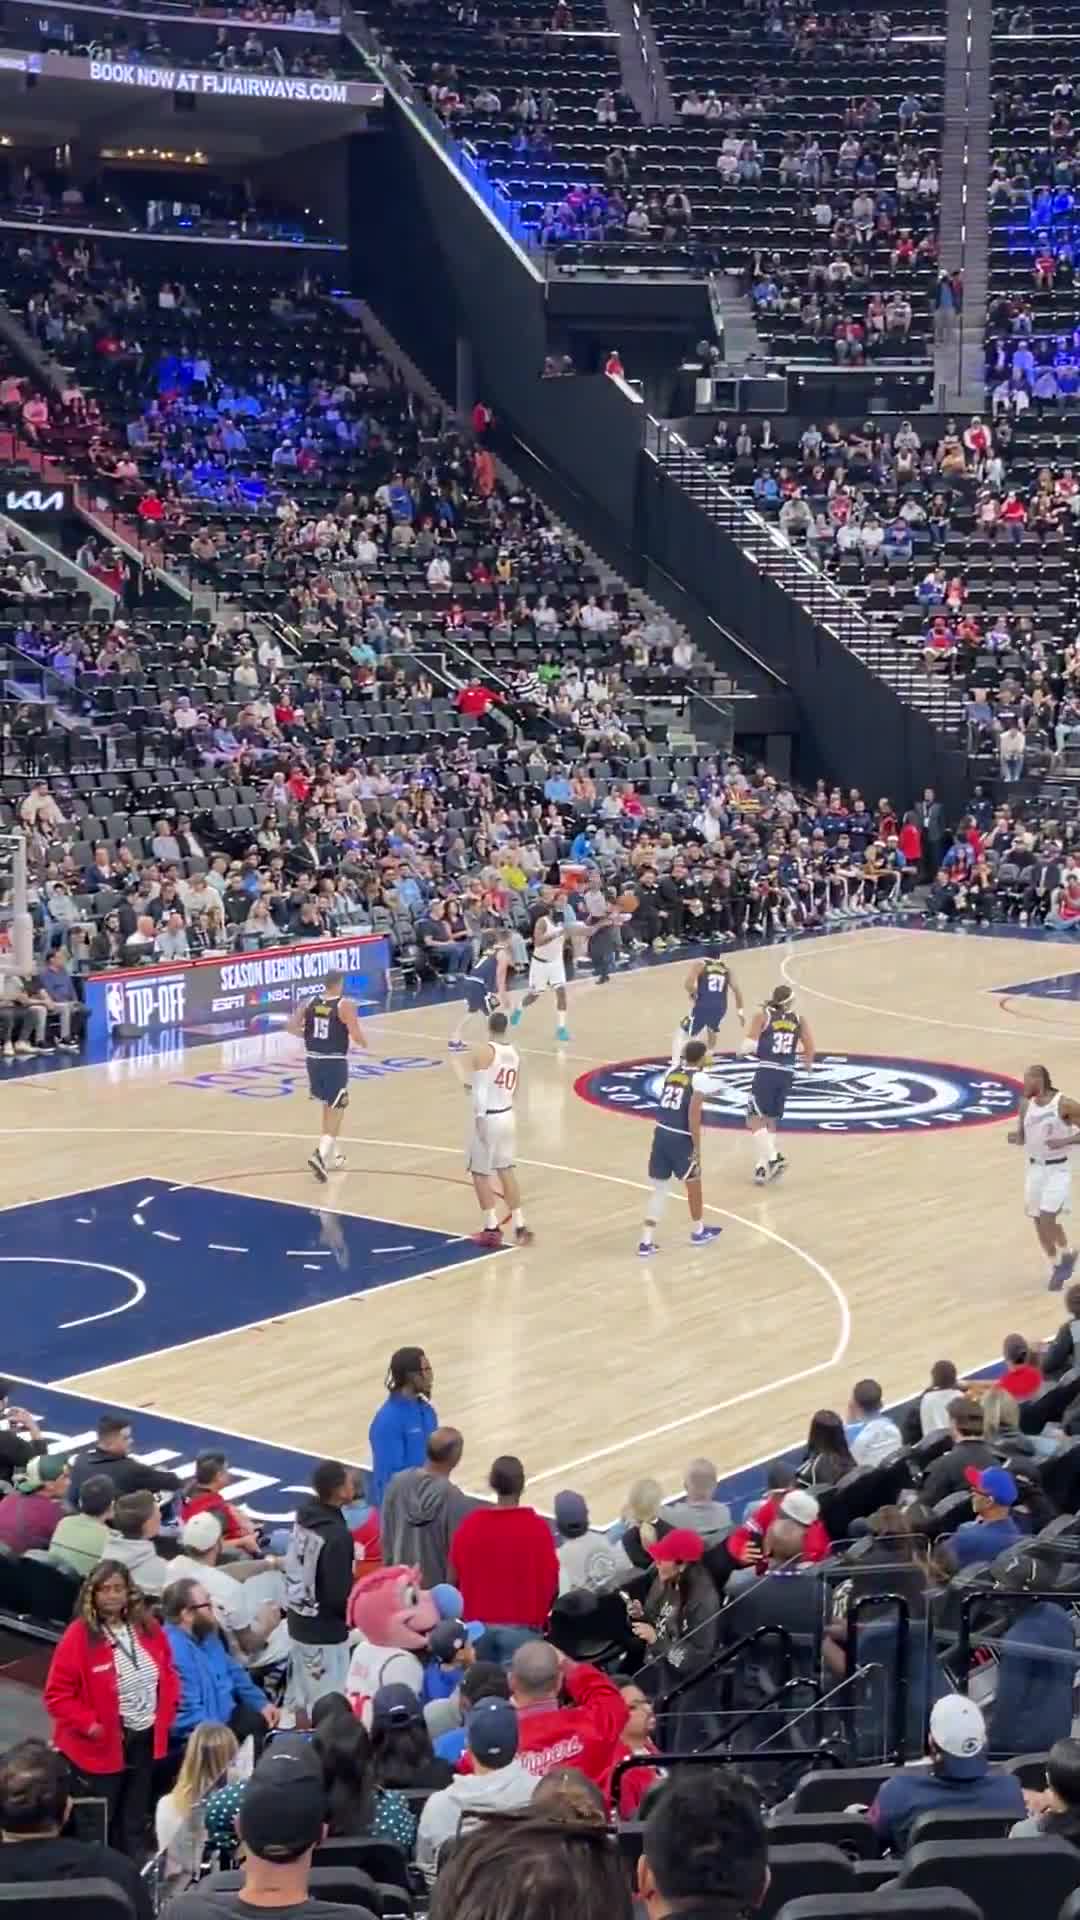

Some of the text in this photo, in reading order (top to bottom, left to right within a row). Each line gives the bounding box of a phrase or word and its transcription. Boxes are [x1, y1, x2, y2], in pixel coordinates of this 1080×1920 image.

[90, 62, 347, 103] BOOK NOW AT FIJIAIRWAYS.COM
[220, 960, 264, 990] SEASON
[264, 955, 302, 984] BEGINS
[350, 946, 361, 971] 21
[126, 982, 186, 1027] TIP-OFF
[212, 995, 245, 1012] ESPN
[268, 988, 290, 1001] NBC
[313, 1017, 329, 1039] 15
[772, 1032, 795, 1054] 32
[494, 1067, 516, 1090] 40
[660, 1086, 684, 1110] 23
[818, 1081, 1013, 1131] CLIPPERS
